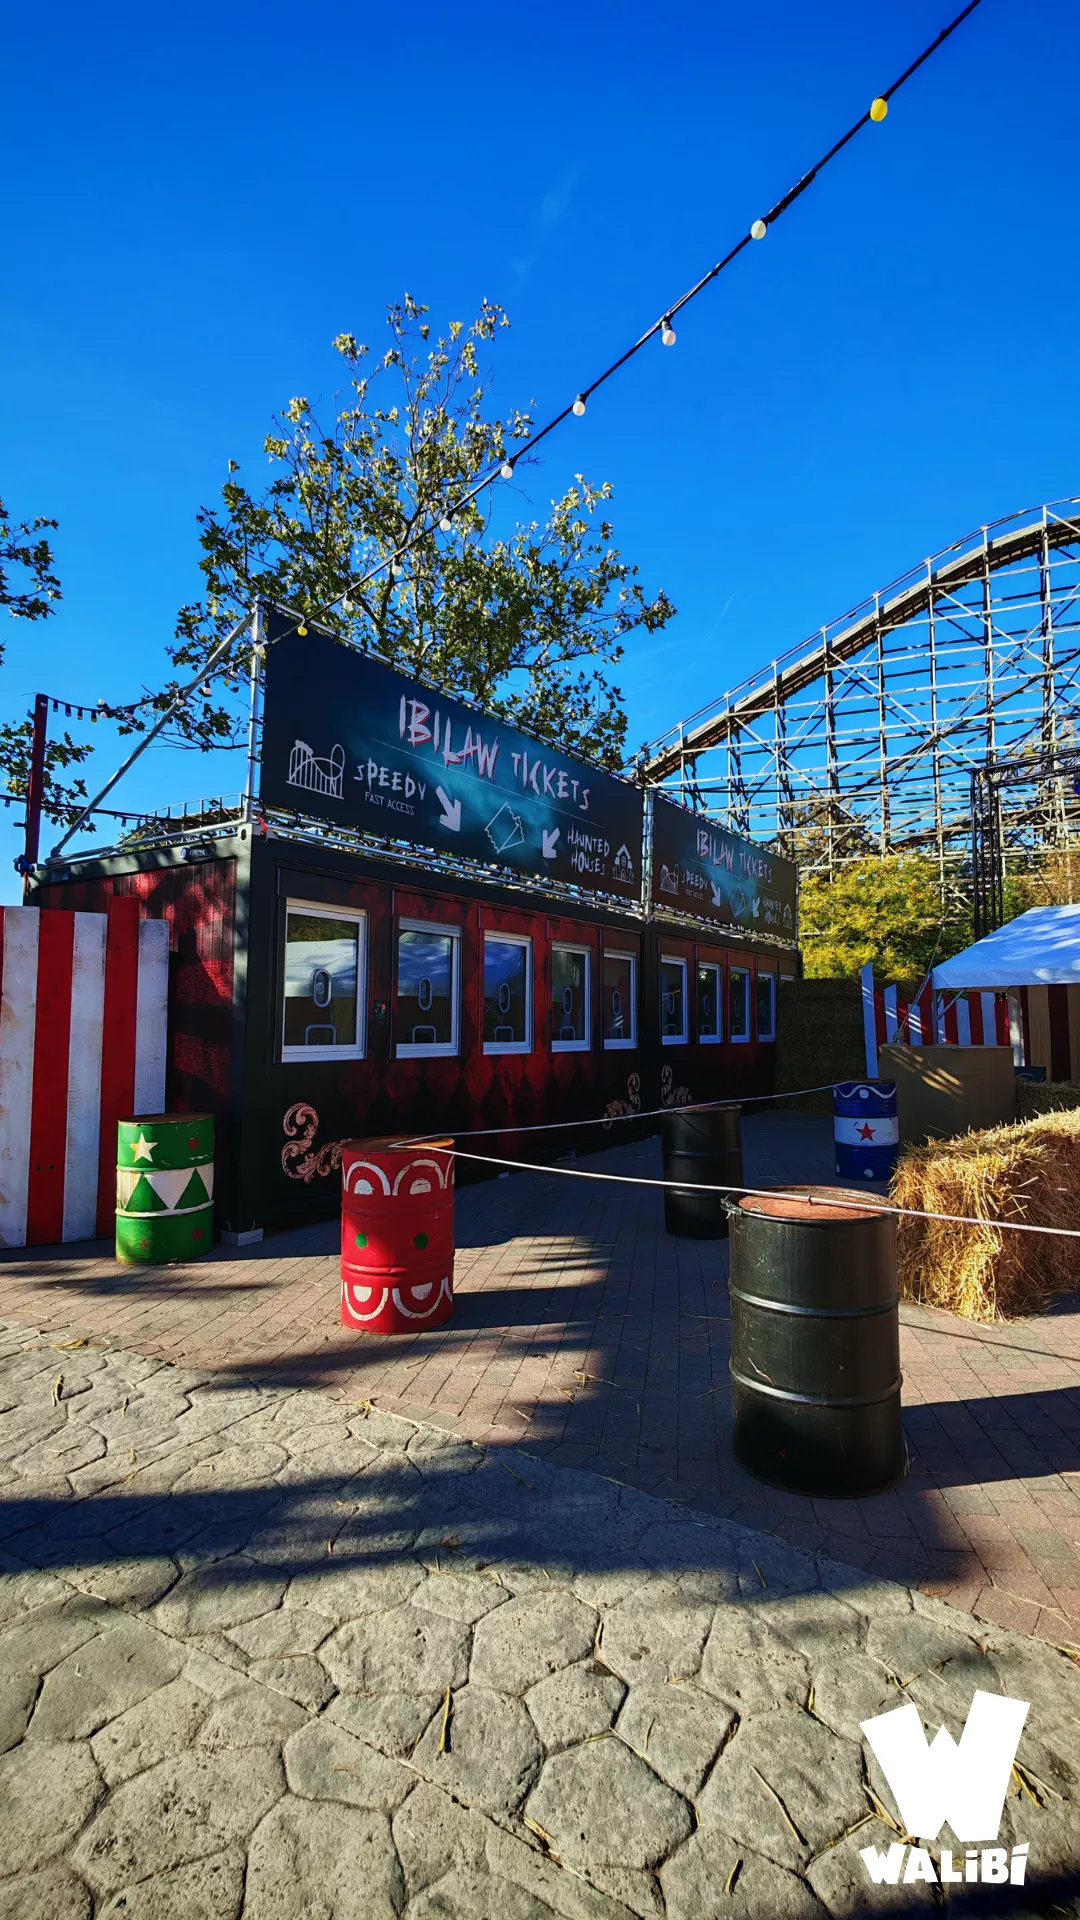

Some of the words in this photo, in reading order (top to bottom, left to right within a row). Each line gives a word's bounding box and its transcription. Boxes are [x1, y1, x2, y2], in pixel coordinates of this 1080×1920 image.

[399, 694, 499, 782] IBILAW
[510, 751, 590, 811] TICKETS
[353, 757, 427, 801] SPEEDY
[364, 791, 385, 806] FAST
[387, 799, 415, 816] ACCESS
[567, 822, 610, 858] HAUNTED
[696, 828, 735, 872] IBILAW
[739, 852, 773, 883] TICKETS
[571, 847, 606, 876] HOUSES
[681, 869, 708, 891] SPEEDY
